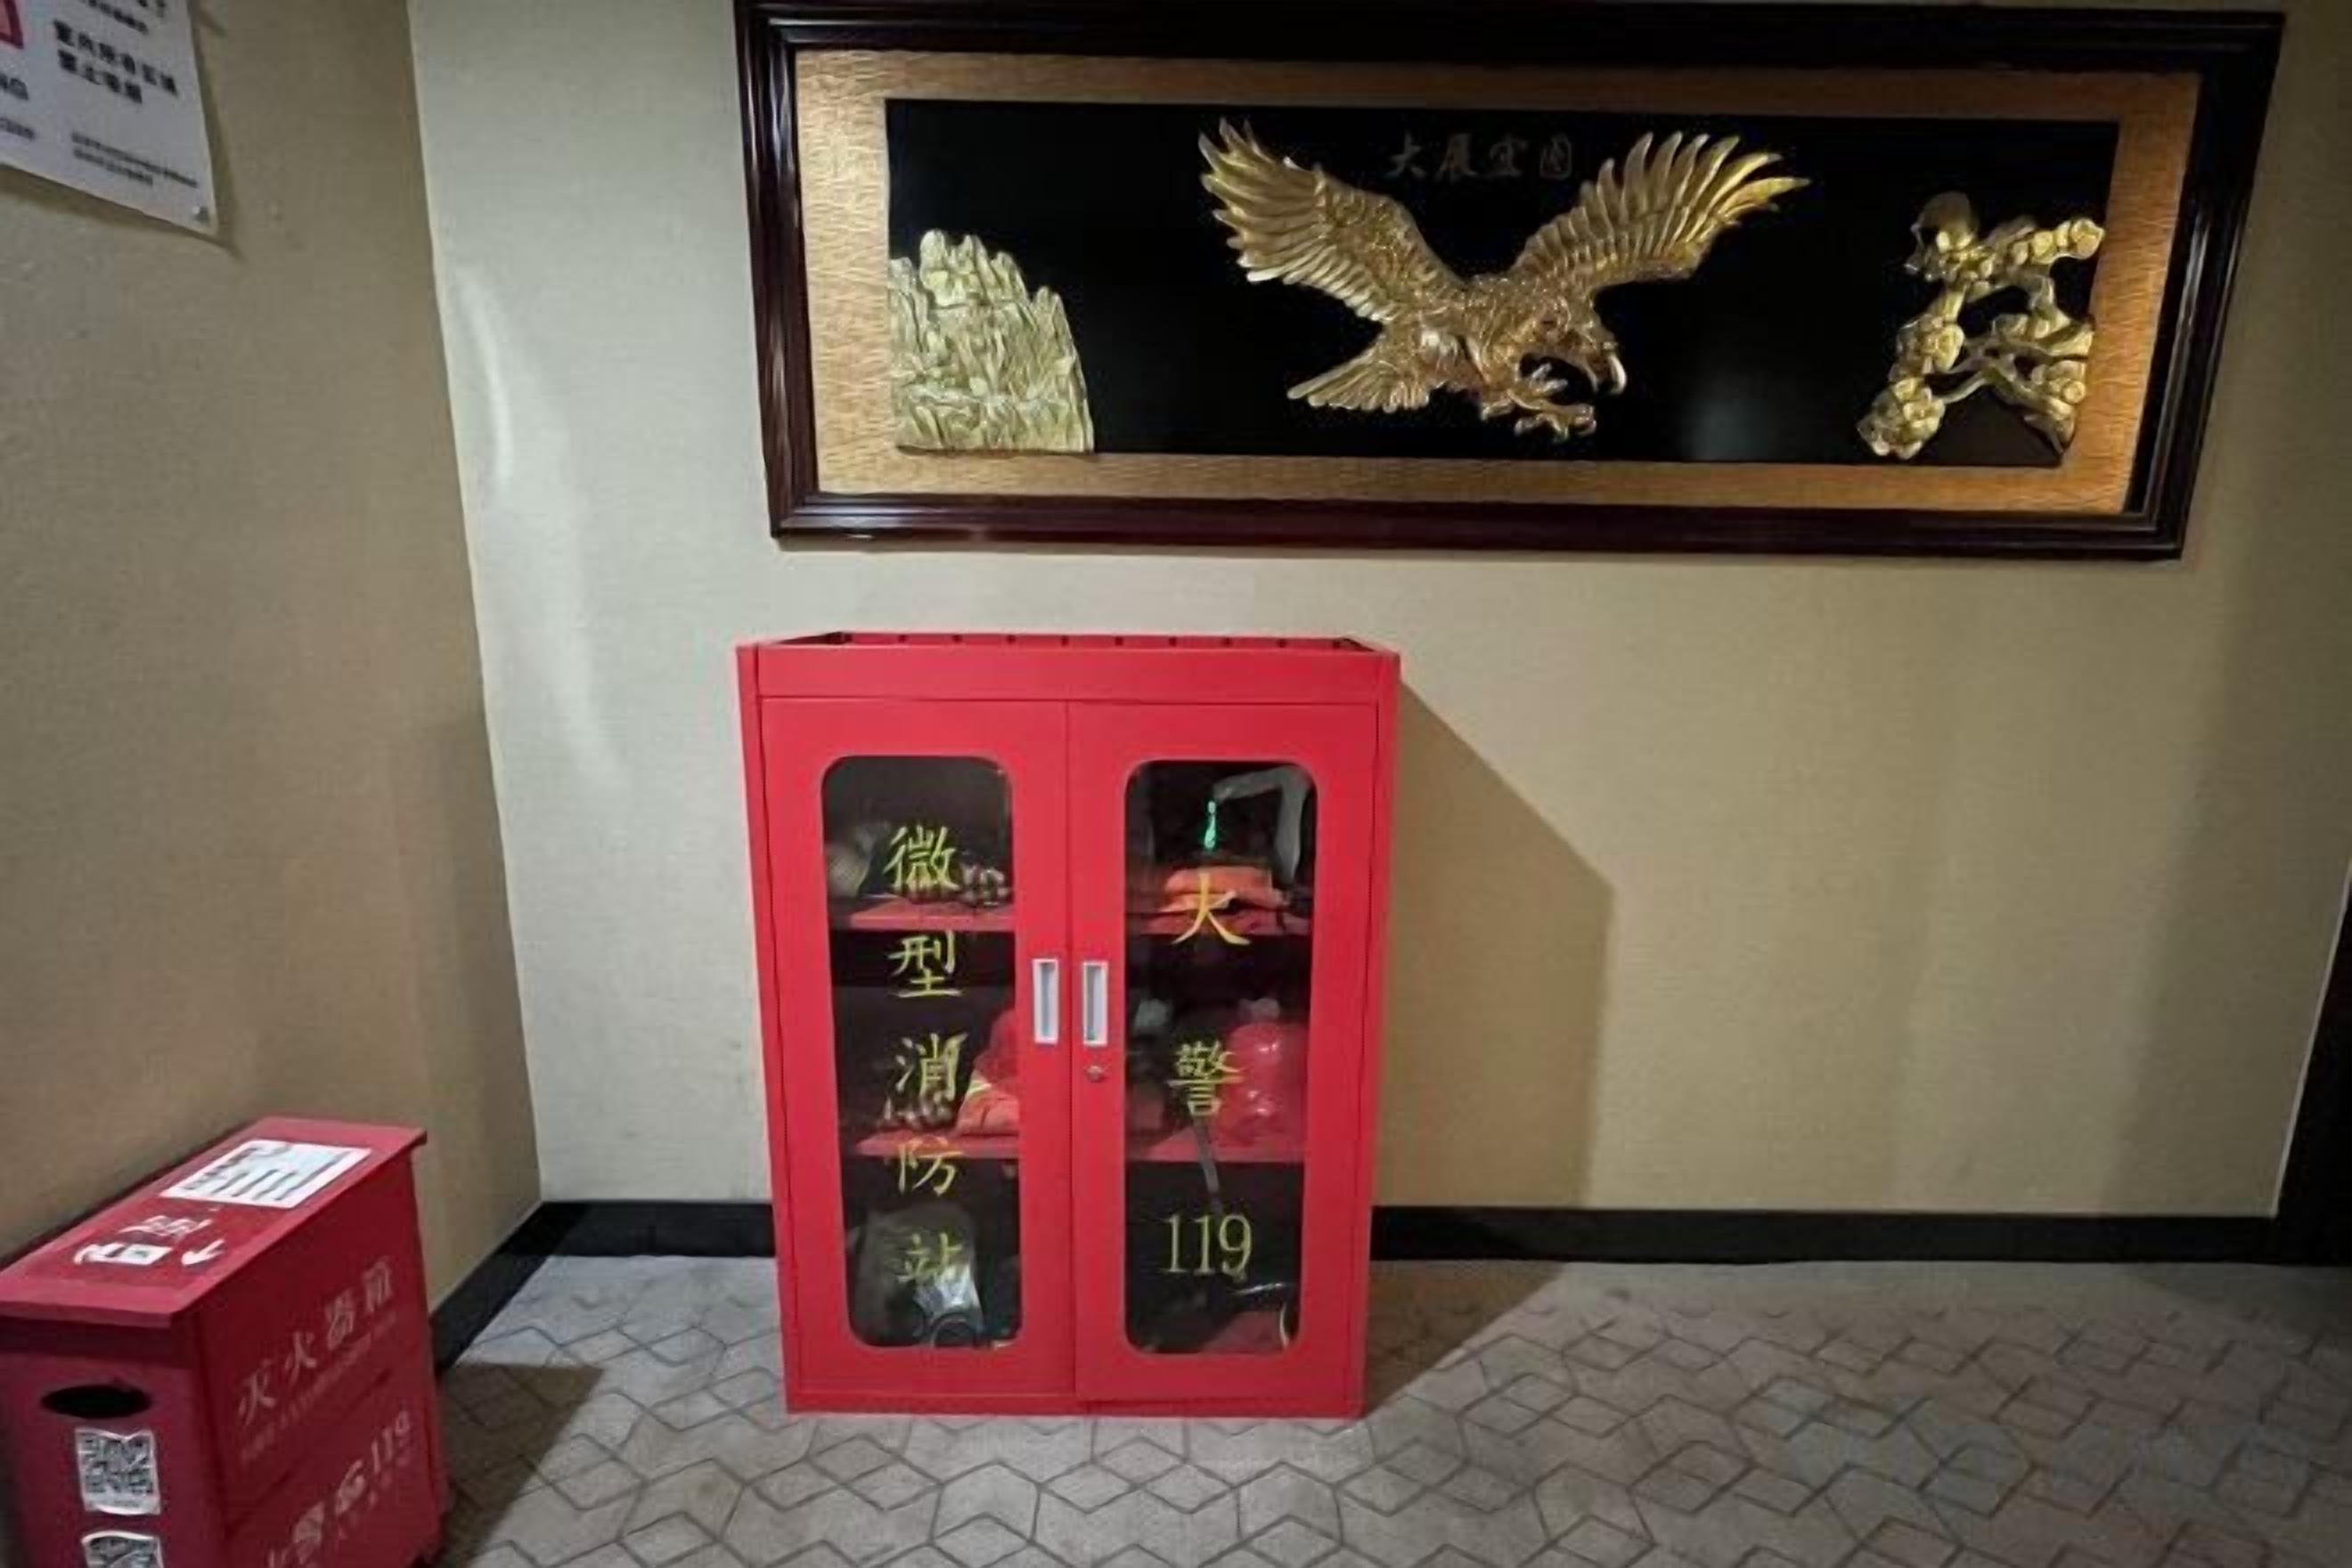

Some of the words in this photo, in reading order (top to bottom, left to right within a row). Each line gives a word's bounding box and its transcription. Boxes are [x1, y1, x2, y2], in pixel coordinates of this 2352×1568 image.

[885, 824, 968, 1283] 微型消防站
[1164, 1213, 1252, 1281] 119
